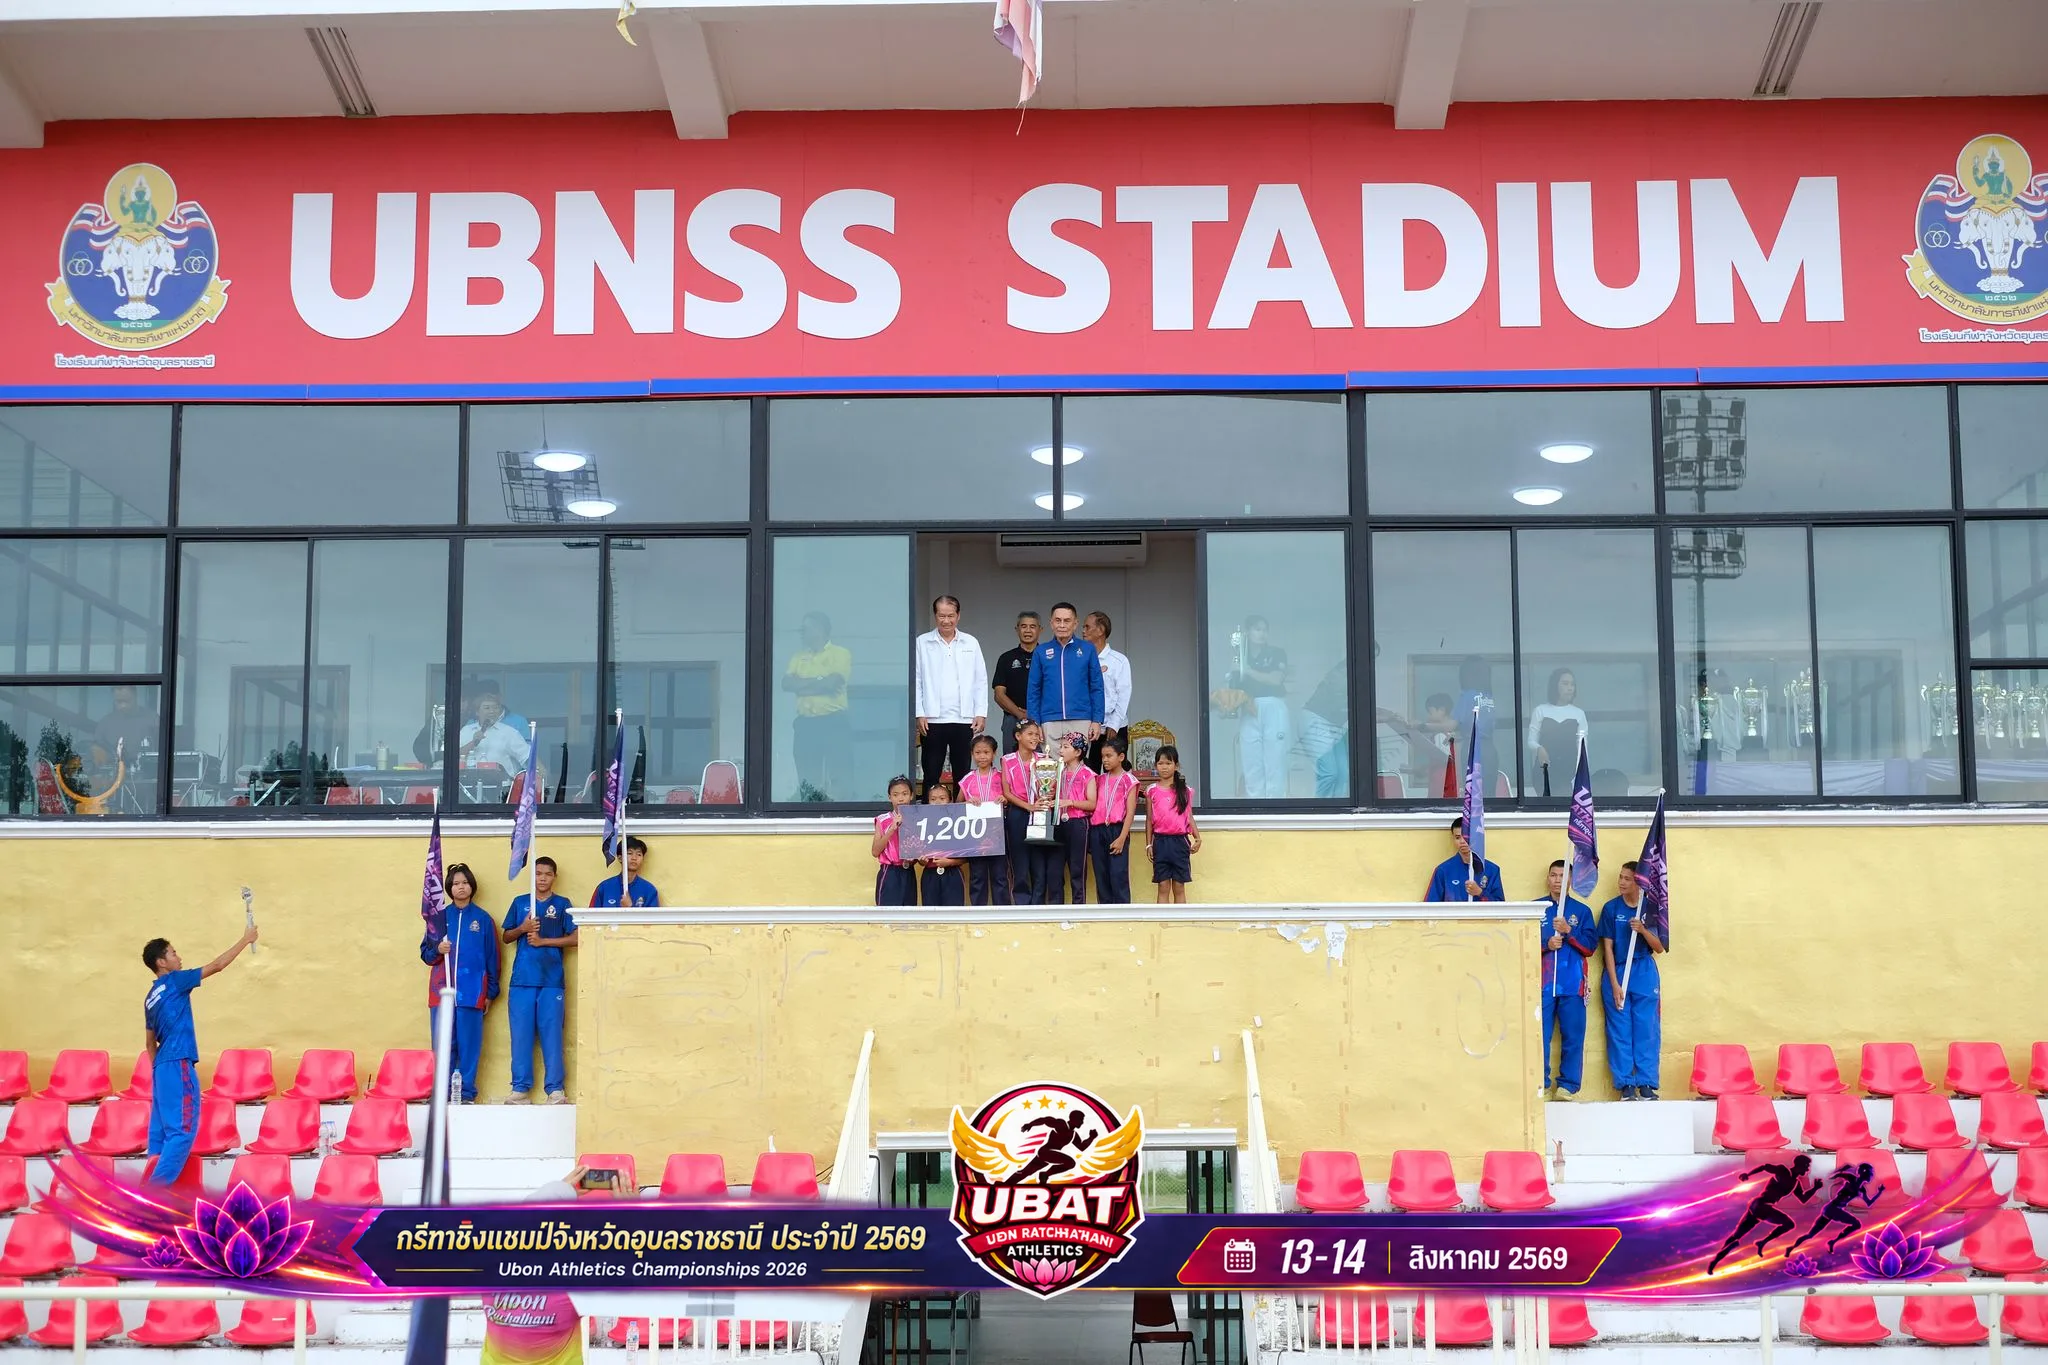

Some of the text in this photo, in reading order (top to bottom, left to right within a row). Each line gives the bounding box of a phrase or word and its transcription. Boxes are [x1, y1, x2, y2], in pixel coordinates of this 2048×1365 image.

[289, 176, 1844, 340] UBNSS STADIUM
[916, 816, 987, 844] 1,200
